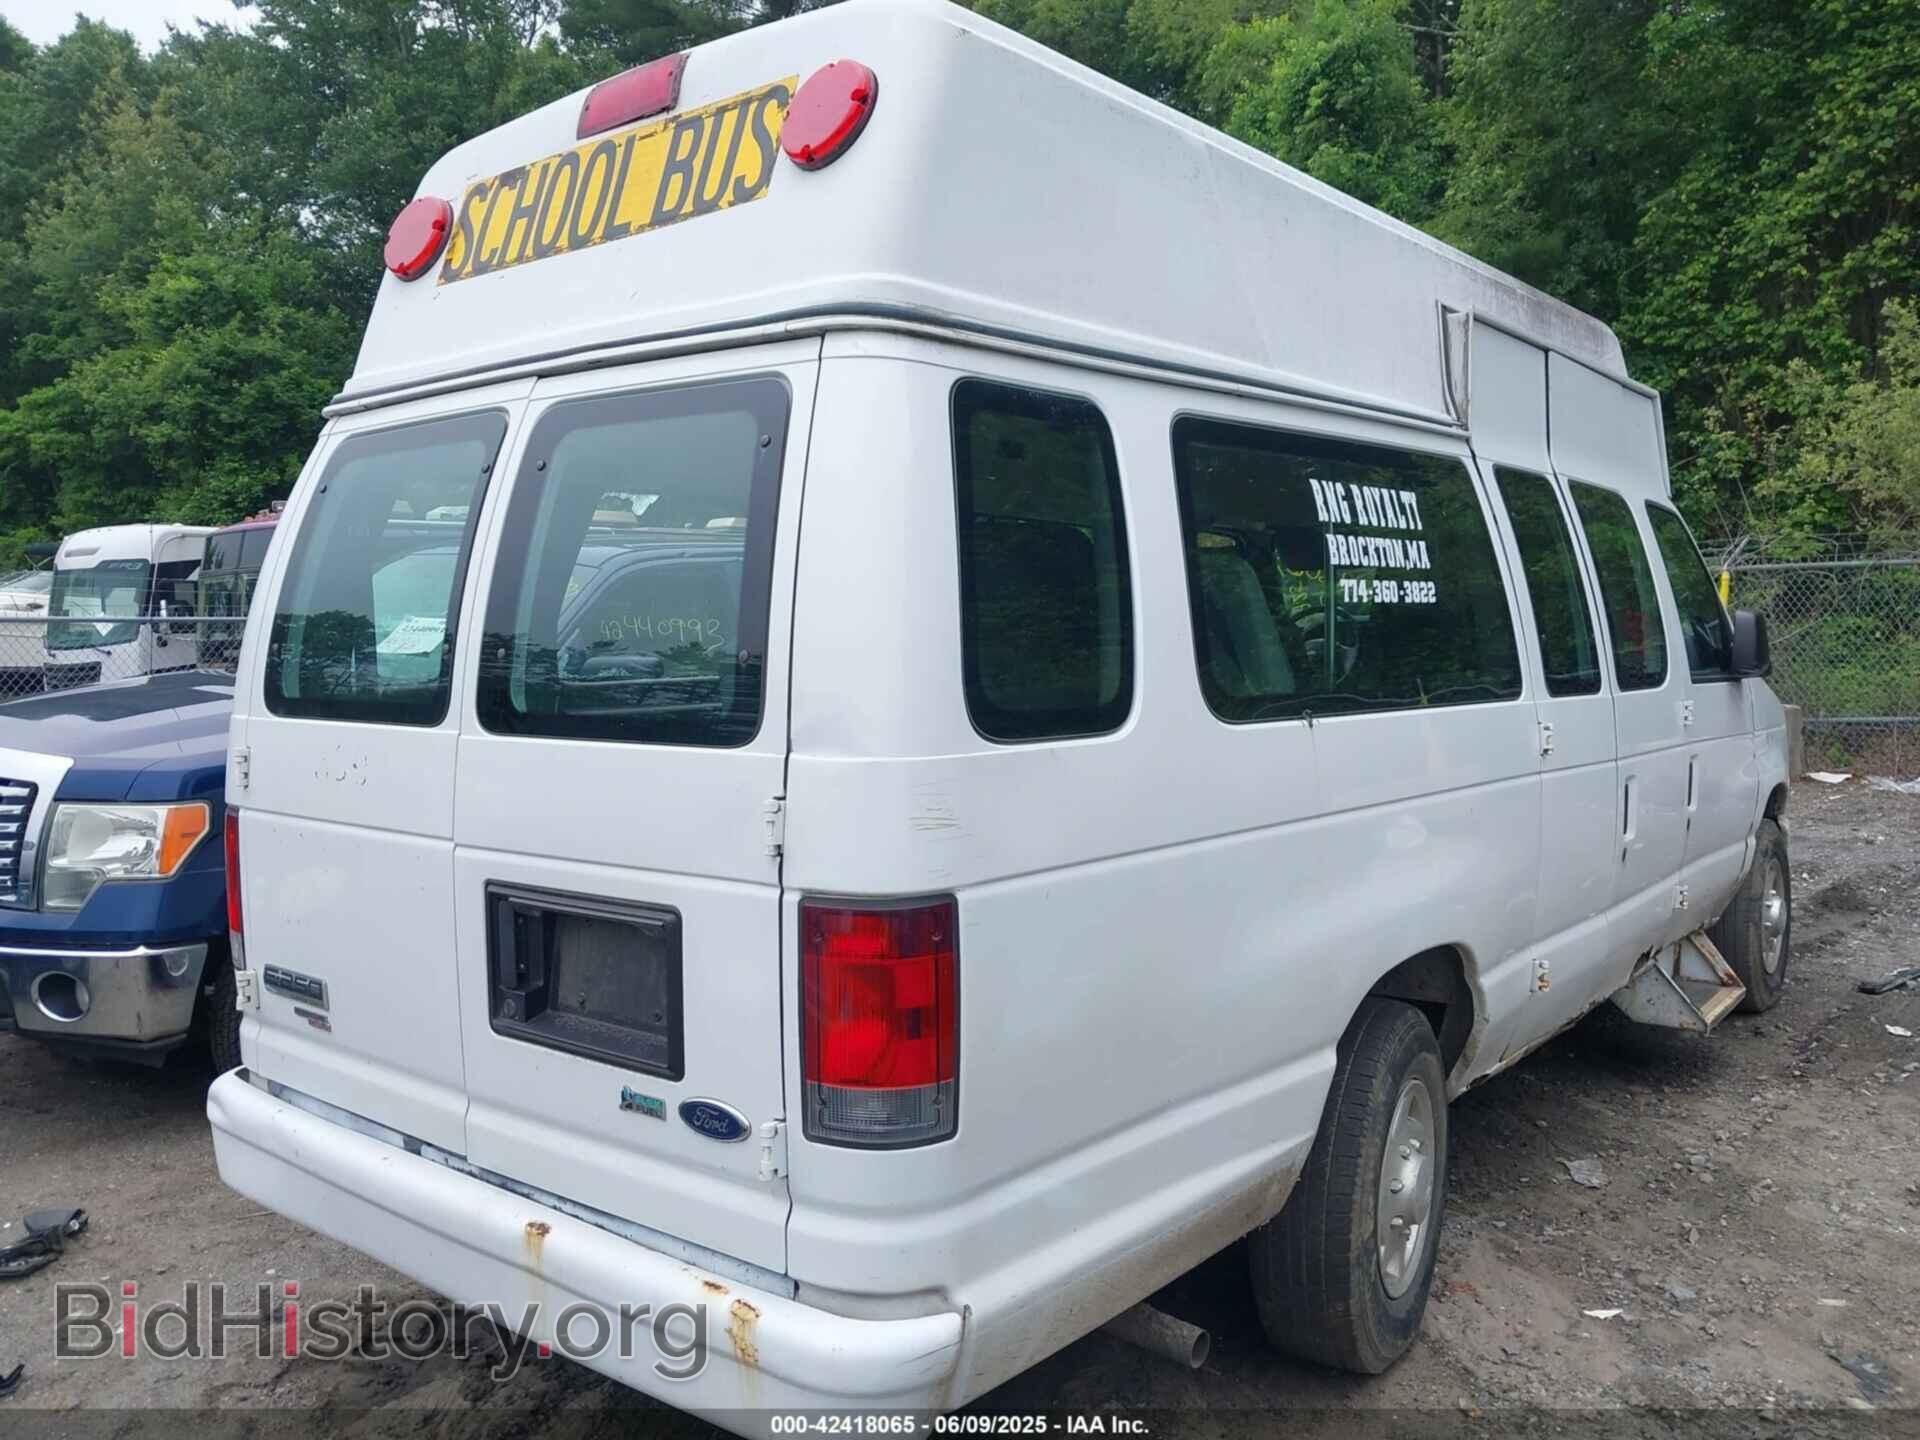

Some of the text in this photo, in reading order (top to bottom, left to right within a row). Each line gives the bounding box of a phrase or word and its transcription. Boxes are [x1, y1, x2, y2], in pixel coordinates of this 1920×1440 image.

[440, 84, 793, 284] SCHOOL BUS
[1326, 533, 1431, 570] BROCKTON,MA
[1340, 578, 1437, 603] 774-360-3822
